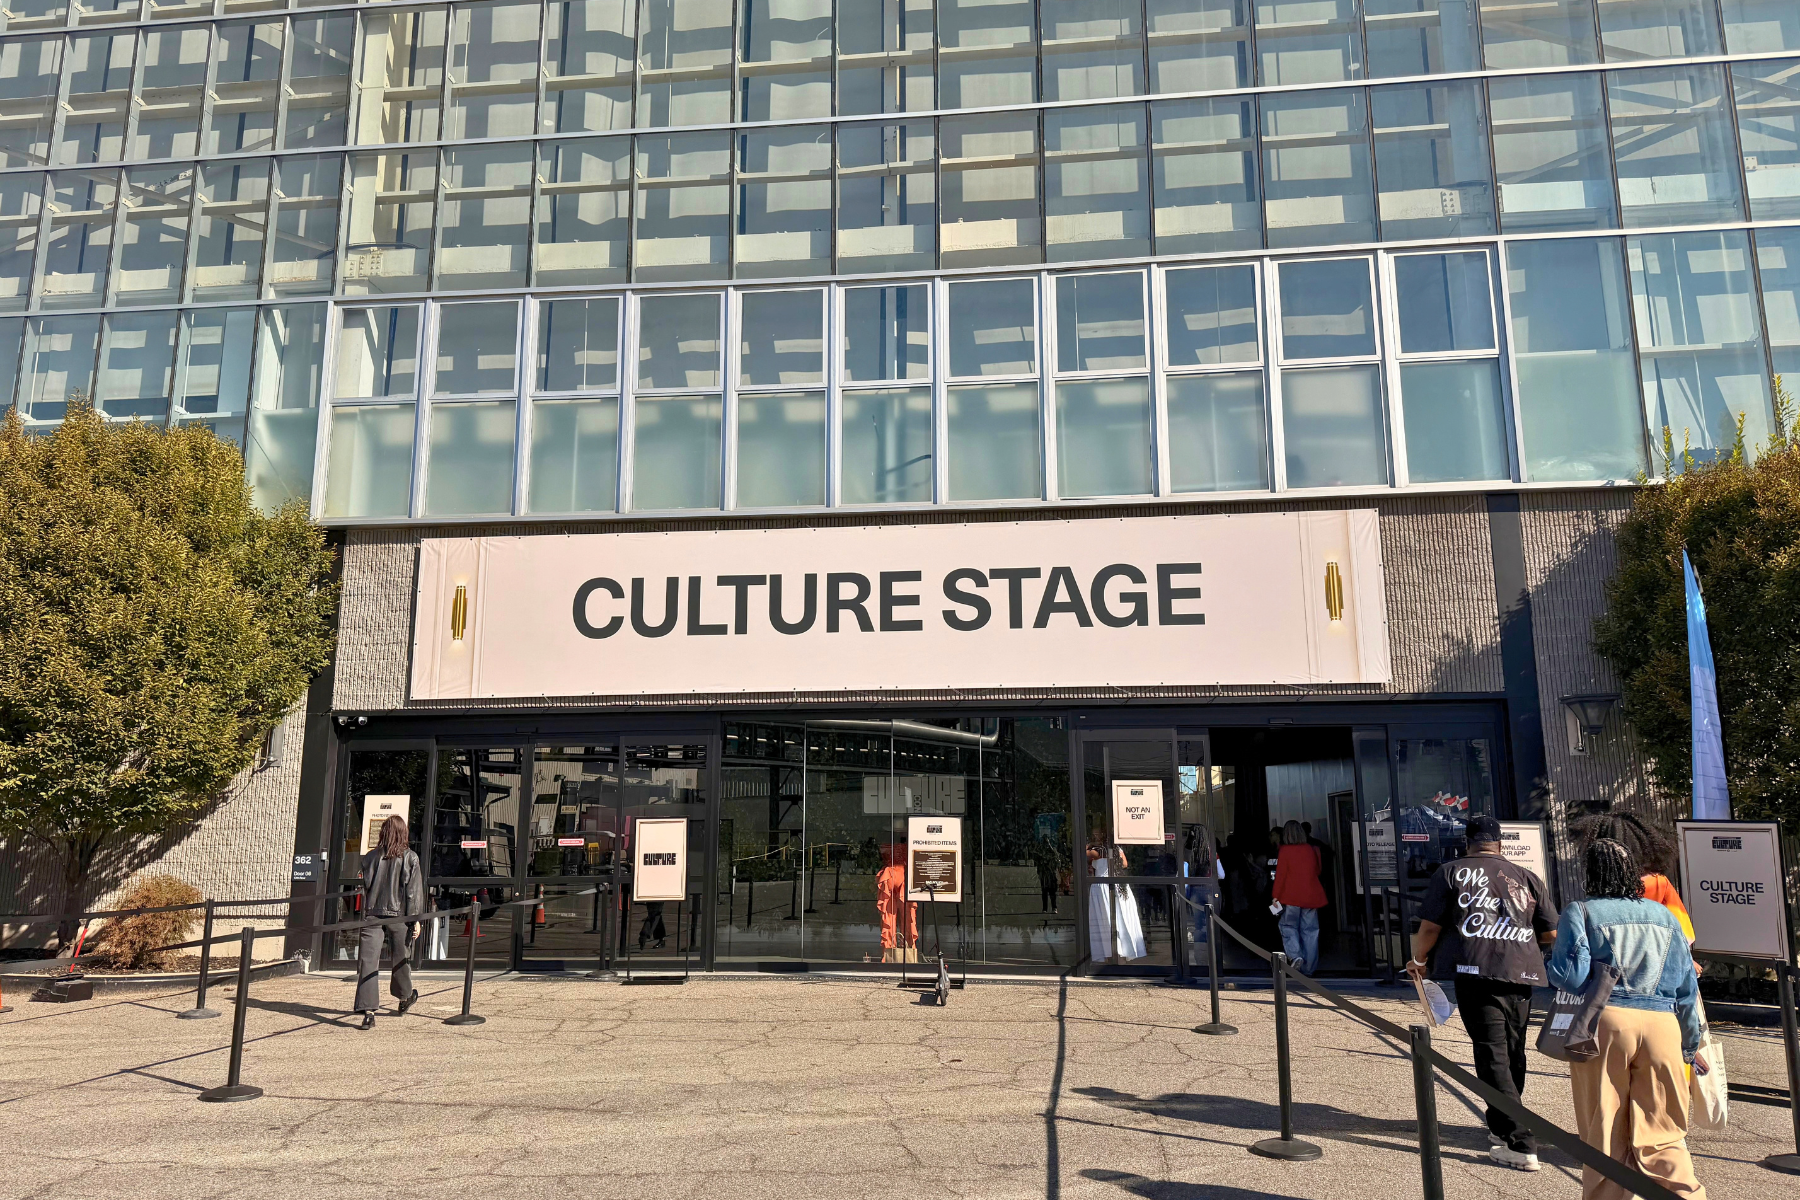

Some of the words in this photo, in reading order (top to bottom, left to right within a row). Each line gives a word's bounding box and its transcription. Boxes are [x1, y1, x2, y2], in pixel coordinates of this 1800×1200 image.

[572, 570, 923, 639] CULTURE
[942, 562, 1205, 631] STAGE
[294, 856, 312, 865] 362
[1456, 867, 1490, 887] We
[1700, 880, 1764, 894] CULTURE
[1458, 887, 1501, 911] Are
[1709, 891, 1756, 906] STAGE
[1461, 912, 1534, 943] Culture
